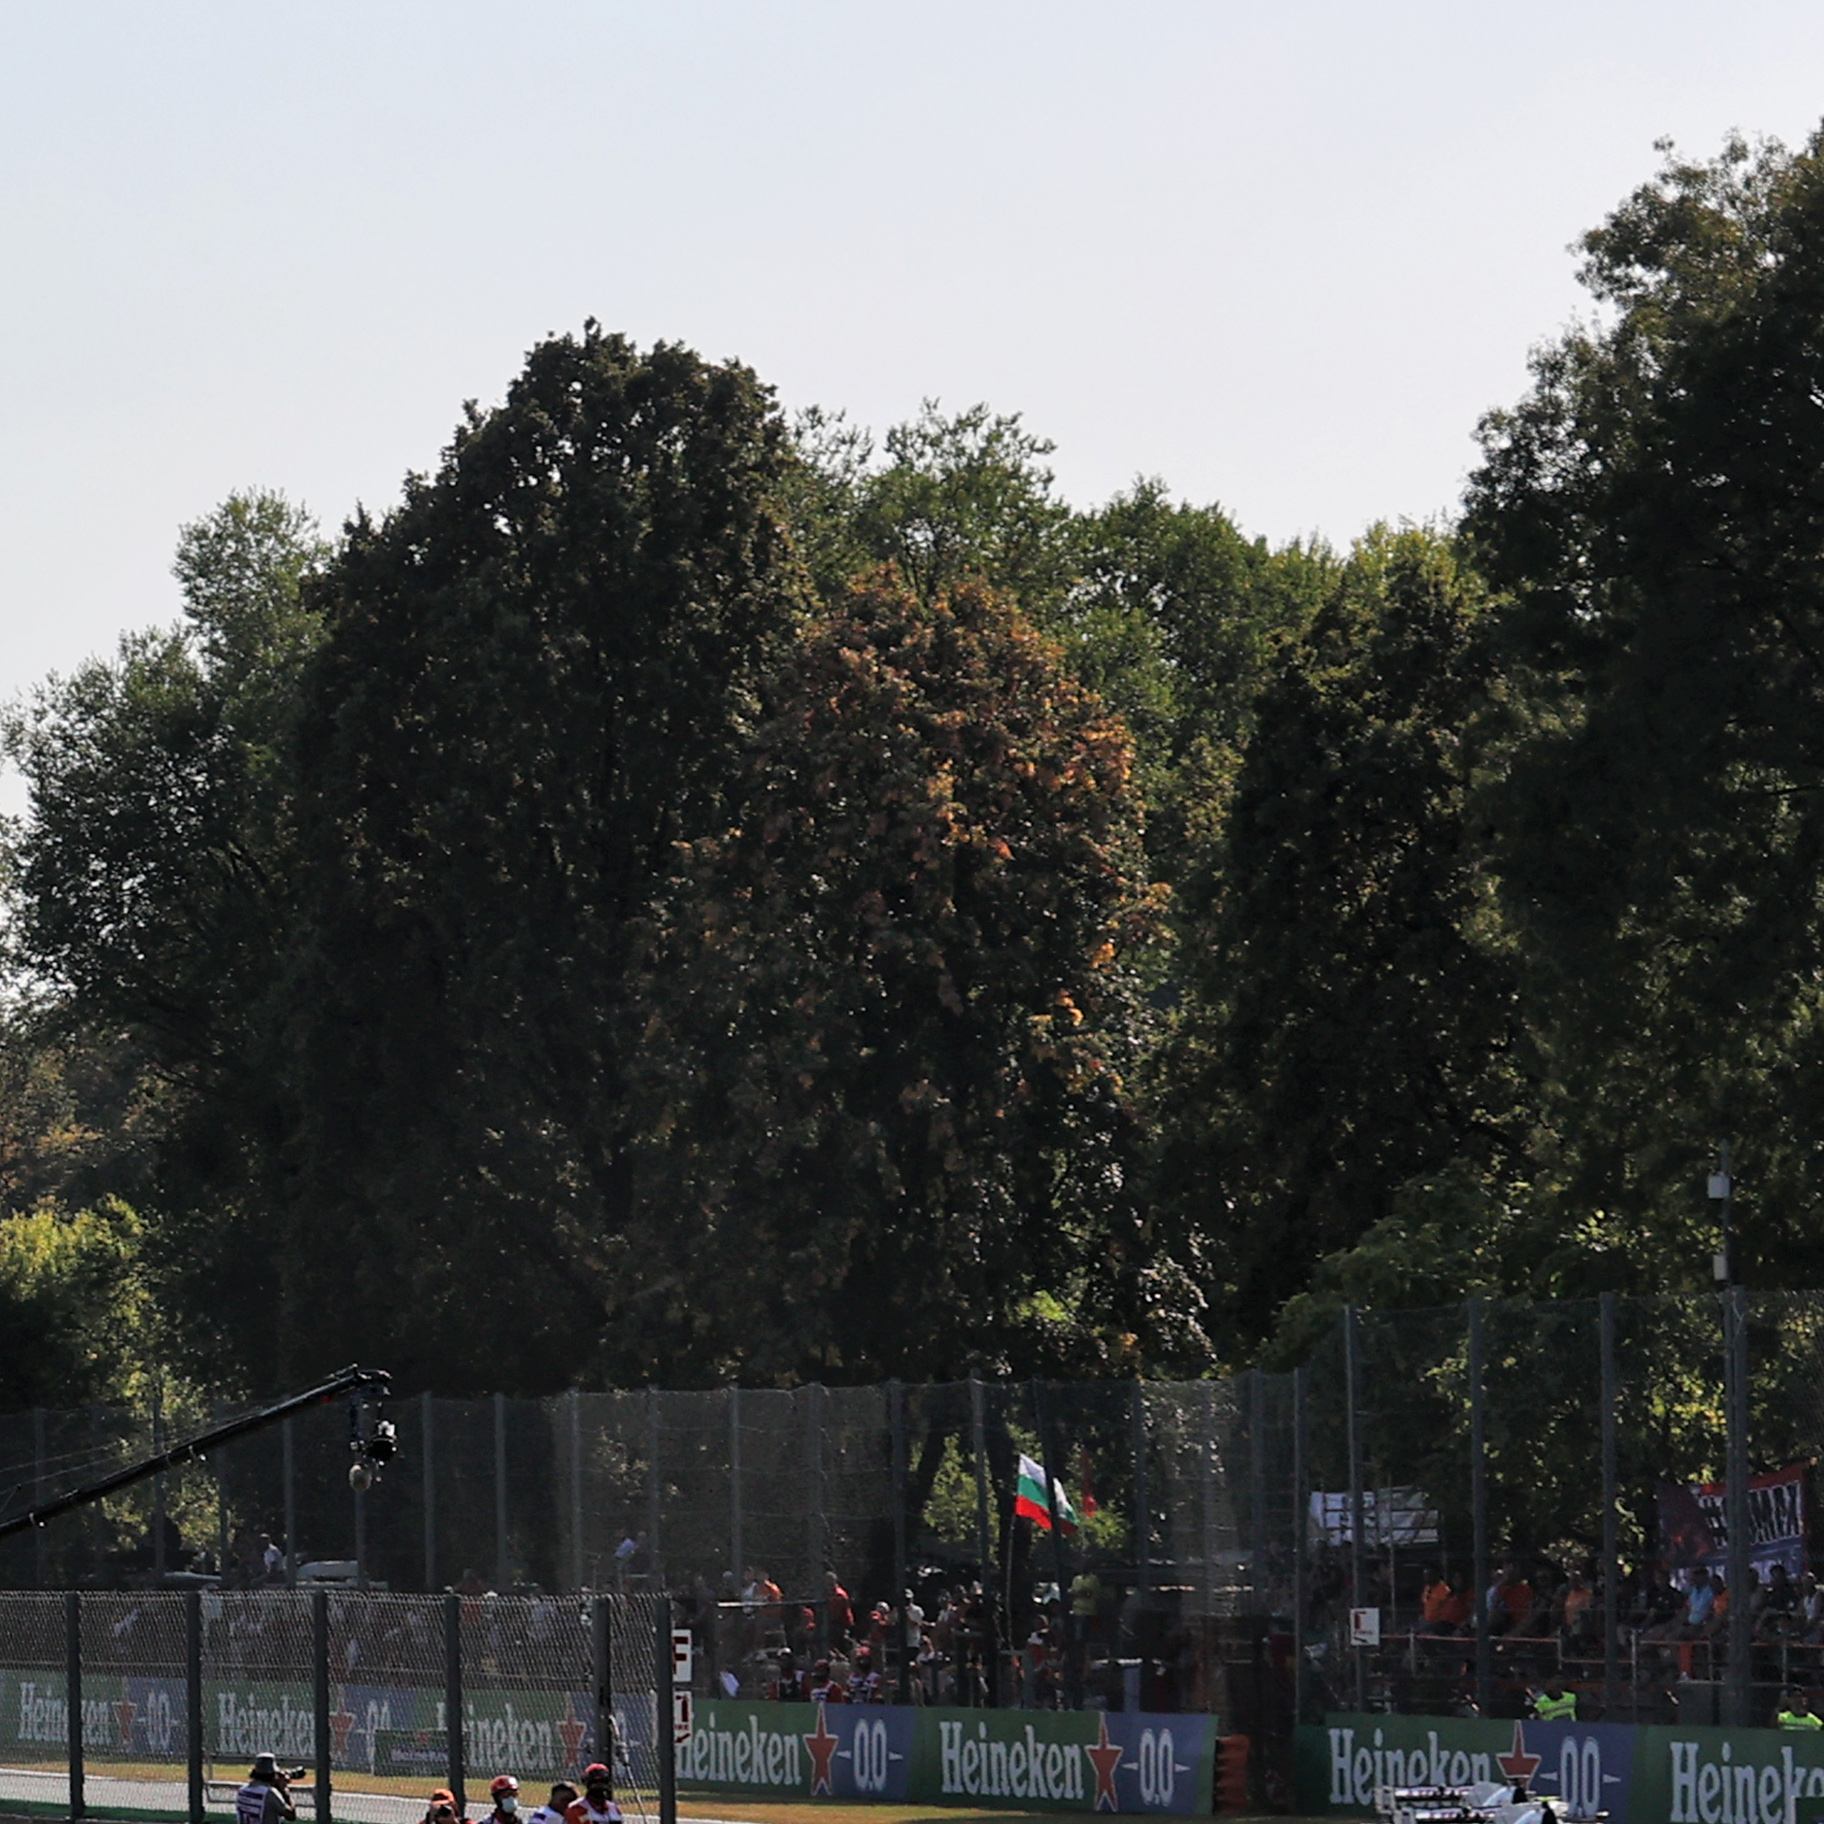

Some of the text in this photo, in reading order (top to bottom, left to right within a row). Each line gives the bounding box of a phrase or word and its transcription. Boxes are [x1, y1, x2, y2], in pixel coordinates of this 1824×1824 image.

[854, 1718, 887, 1792] 0.0
[938, 1721, 1175, 1807] Heineken 0.0
